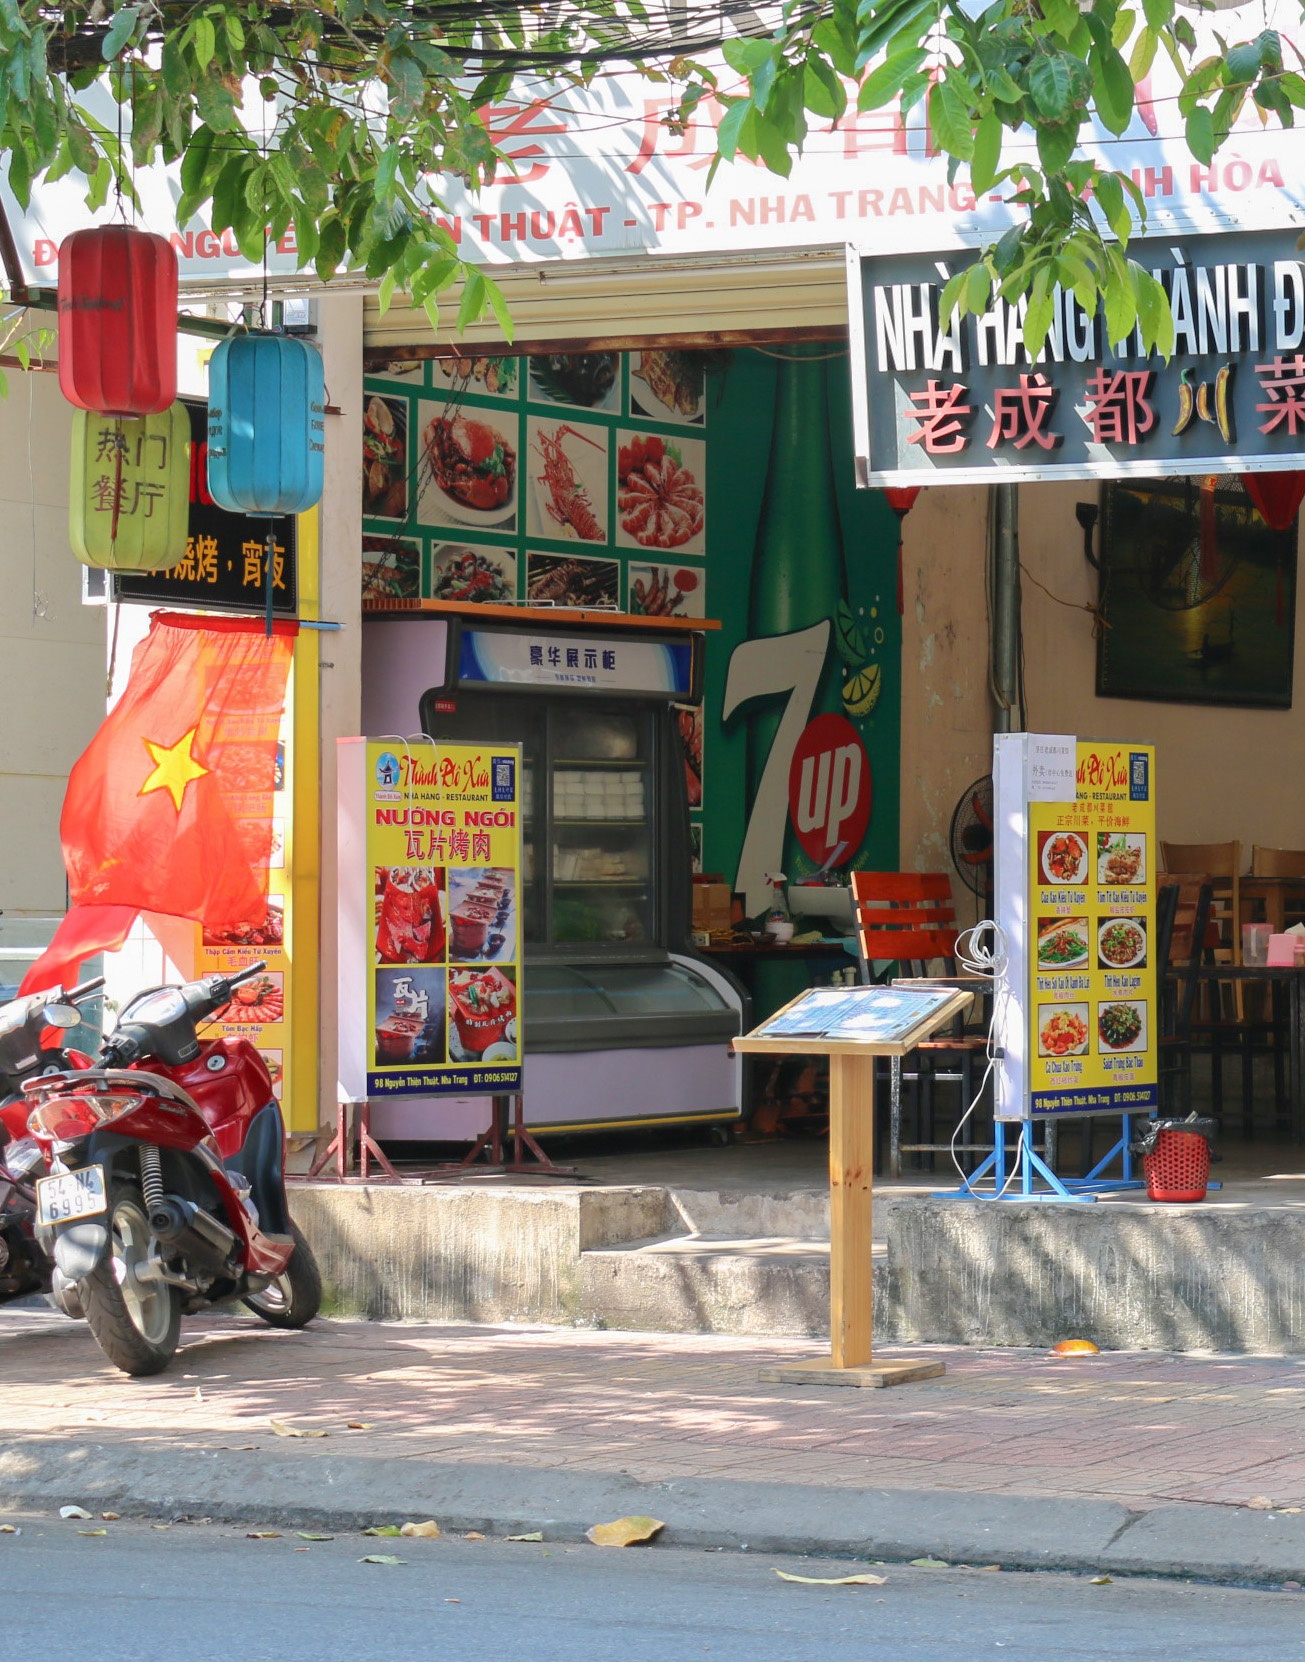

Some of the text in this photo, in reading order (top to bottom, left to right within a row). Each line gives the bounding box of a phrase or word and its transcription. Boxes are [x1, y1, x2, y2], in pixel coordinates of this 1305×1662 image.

[472, 201, 610, 243] THUẬT
[648, 201, 714, 232] TP.
[729, 194, 816, 227] NHA
[828, 182, 977, 220] TRANG
[1190, 152, 1285, 193] HÒA
[144, 534, 286, 590] 烧烤，宵夜
[530, 646, 616, 670] 豪华展示柜
[400, 755, 438, 787] Thành
[446, 794, 488, 802] RESTAURANT
[1092, 792, 1127, 800] RESTAURANT
[404, 828, 491, 862] 瓦片烤肉
[441, 1076, 452, 1085] Nha
[453, 1075, 468, 1086] Trang
[50, 1193, 96, 1220] 6995
